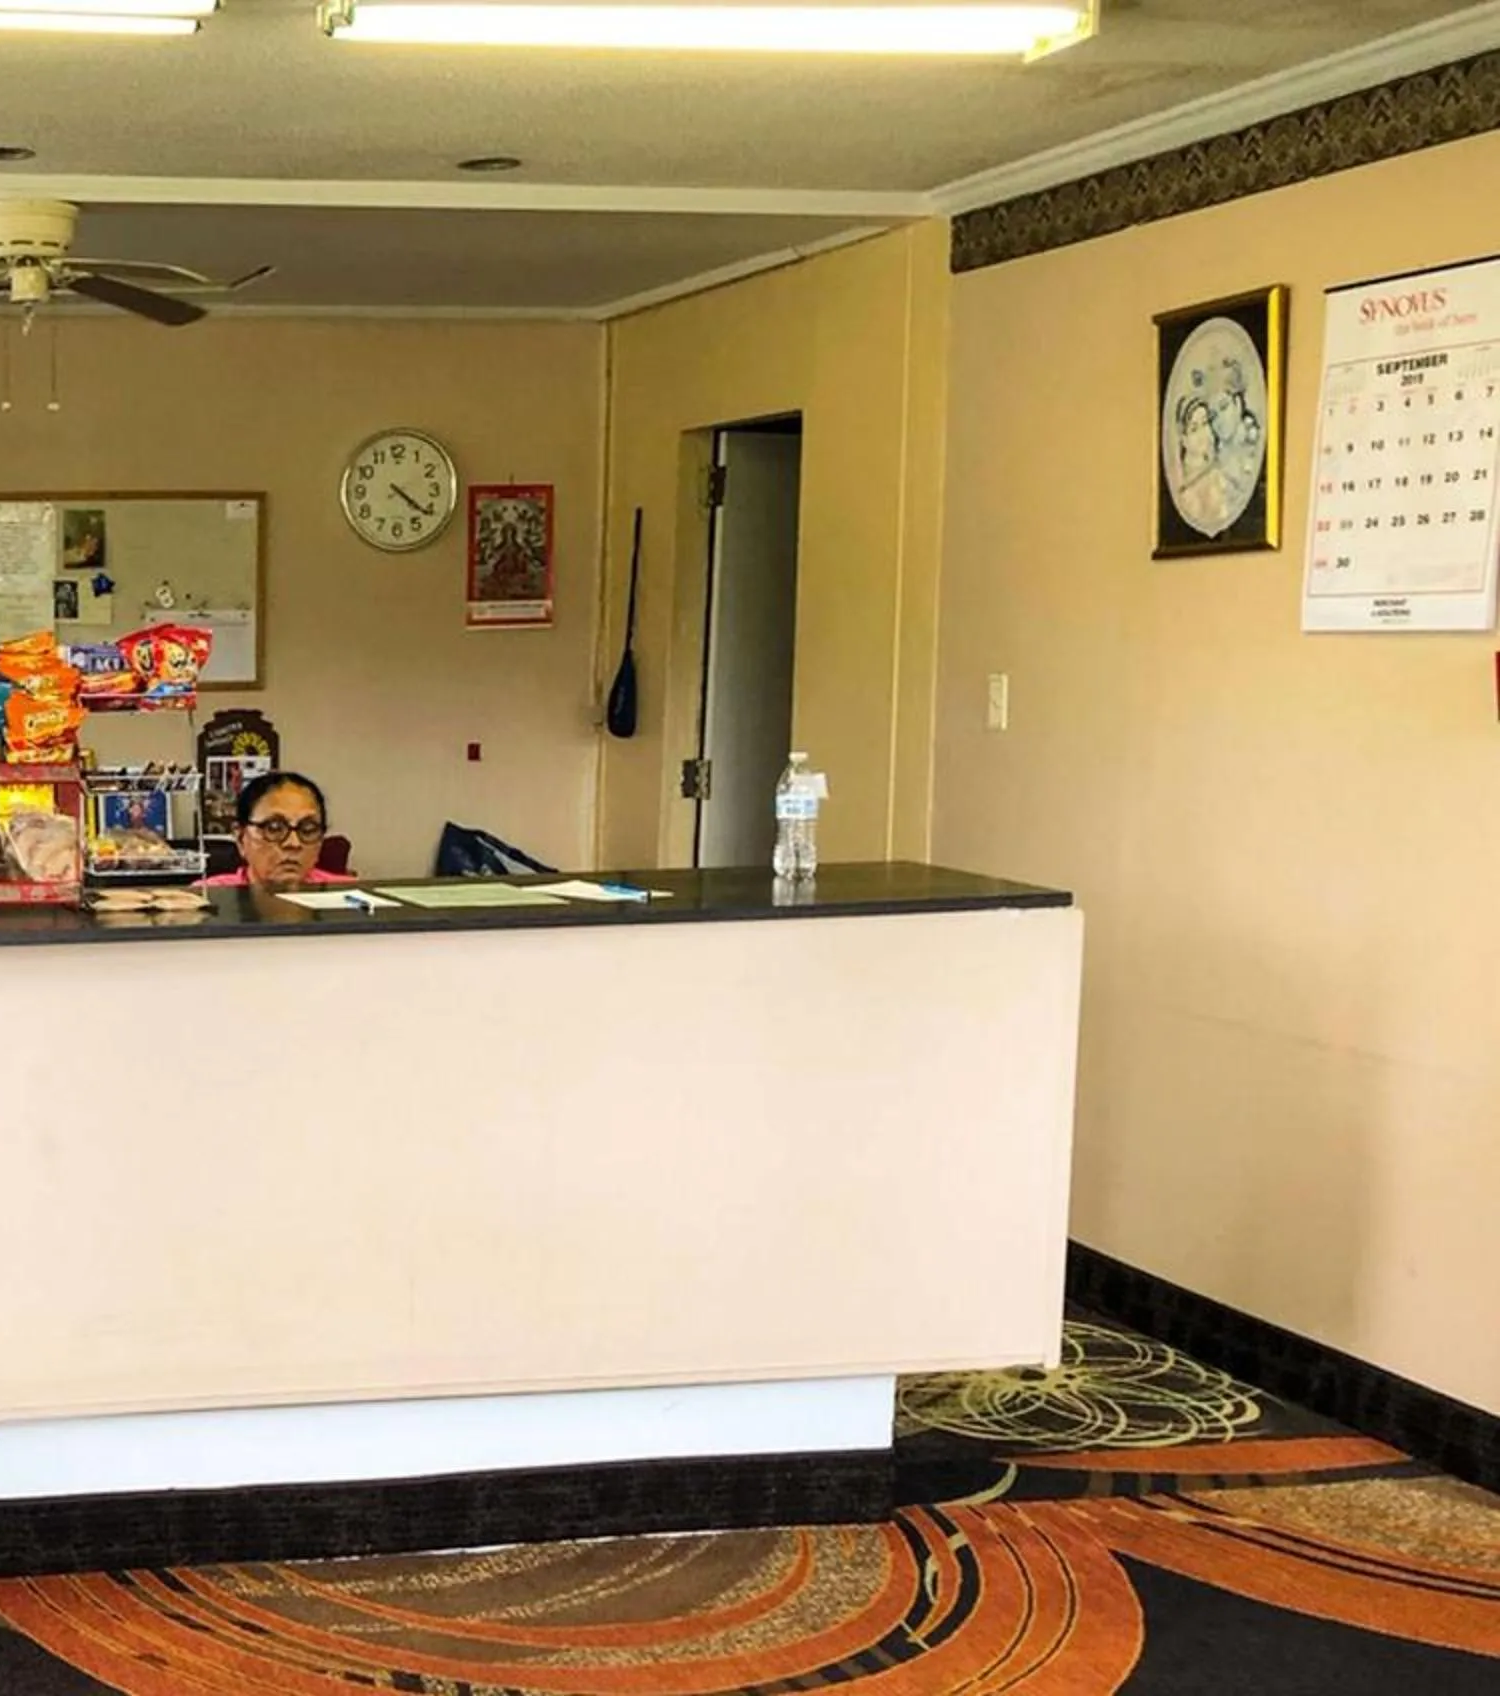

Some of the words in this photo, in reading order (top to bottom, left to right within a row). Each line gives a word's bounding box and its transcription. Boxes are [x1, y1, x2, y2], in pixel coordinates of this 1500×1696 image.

[1377, 353, 1448, 376] SEPTEMBER
[373, 450, 385, 464] 11
[390, 444, 406, 459] 12
[414, 450, 420, 463] 1
[359, 464, 375, 480] 10
[424, 463, 436, 478] 2
[354, 484, 367, 499] 9
[428, 482, 440, 497] 3
[359, 504, 371, 520] 8
[375, 517, 386, 532] 7
[391, 522, 403, 538] 6
[410, 516, 422, 532] 5
